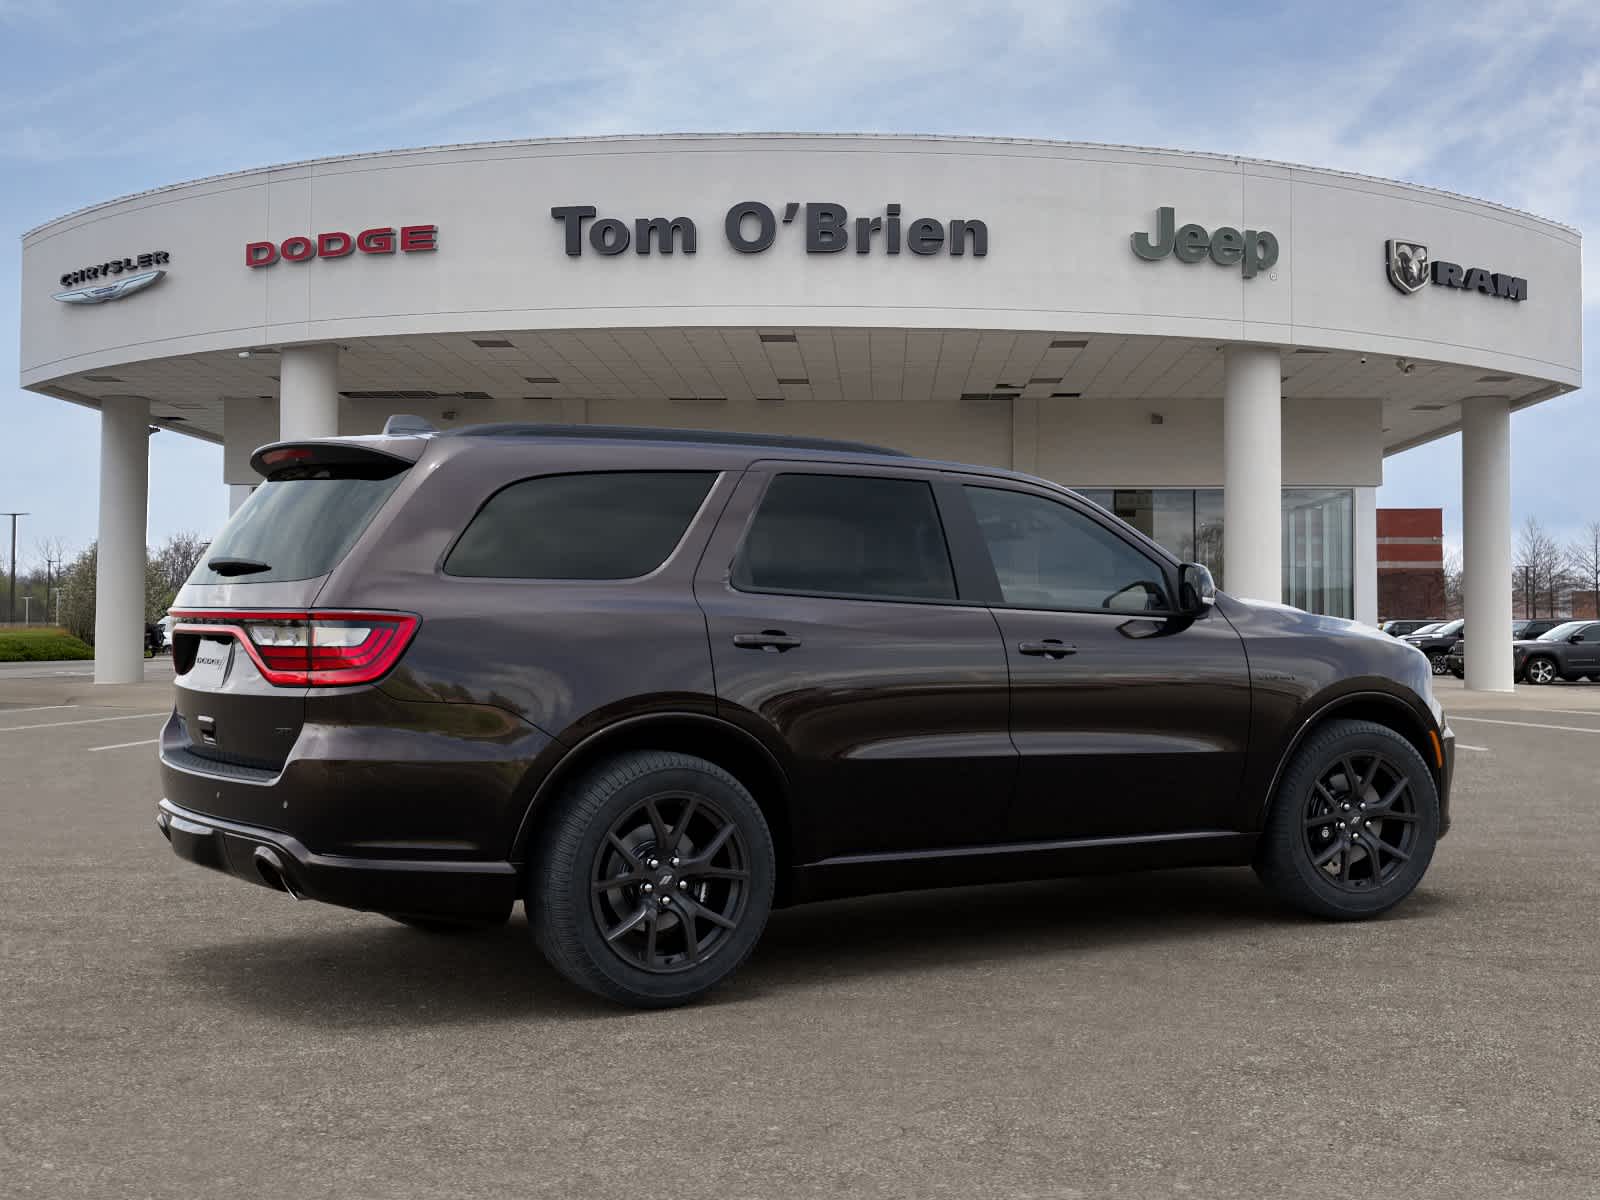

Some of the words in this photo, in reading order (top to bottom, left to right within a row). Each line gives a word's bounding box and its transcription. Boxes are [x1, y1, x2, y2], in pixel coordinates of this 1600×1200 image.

[245, 225, 437, 269] DODGE
[551, 205, 696, 256] Tom
[725, 201, 988, 257] O'Brien
[1130, 207, 1279, 278] Jeep
[60, 250, 170, 287] CHRYSLER
[1431, 260, 1527, 301] RAM
